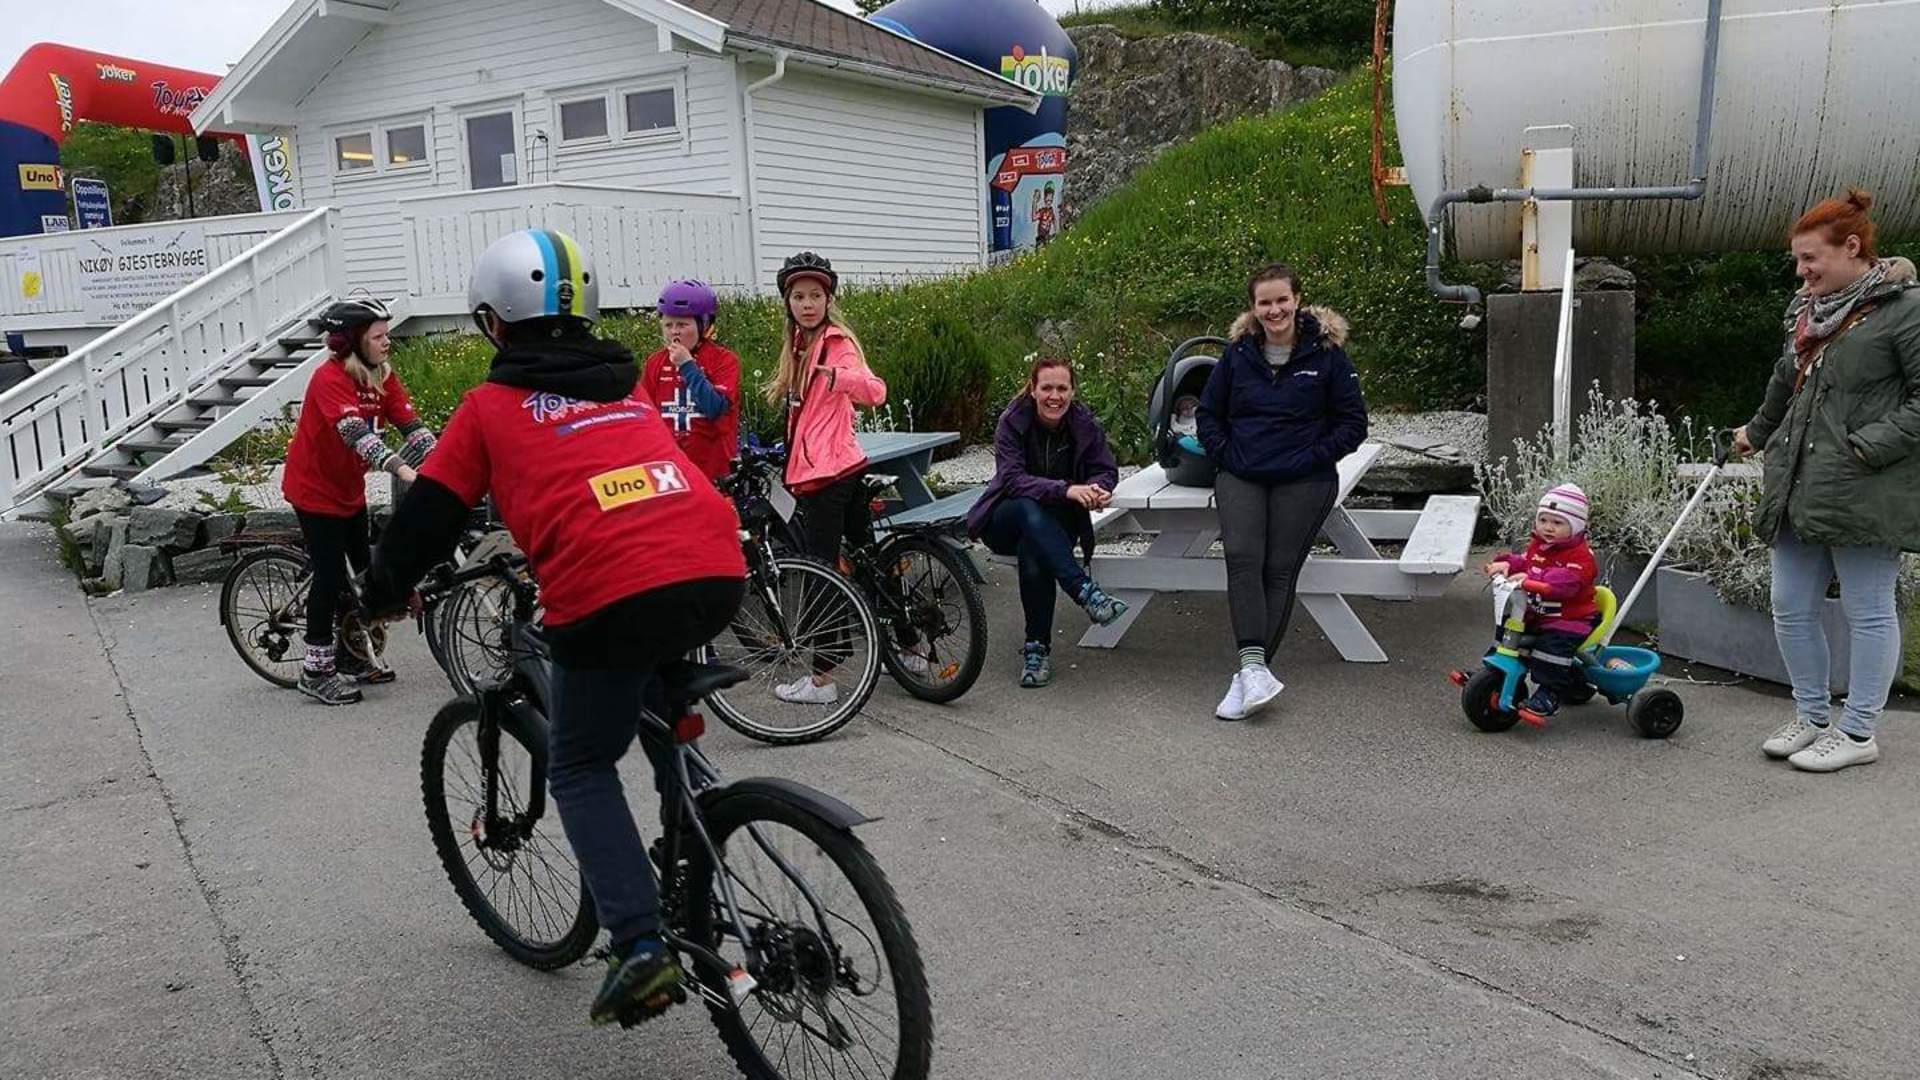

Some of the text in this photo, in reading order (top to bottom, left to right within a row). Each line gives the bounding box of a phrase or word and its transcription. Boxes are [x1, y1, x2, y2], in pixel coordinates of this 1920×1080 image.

[98, 64, 135, 82] joker
[55, 76, 73, 132] joker
[26, 170, 54, 182] Uno
[261, 136, 294, 211] oker
[80, 249, 204, 274] NIKØY GJESTEBRYGGE
[669, 405, 694, 413] NORGE
[603, 464, 684, 498] Uno X
